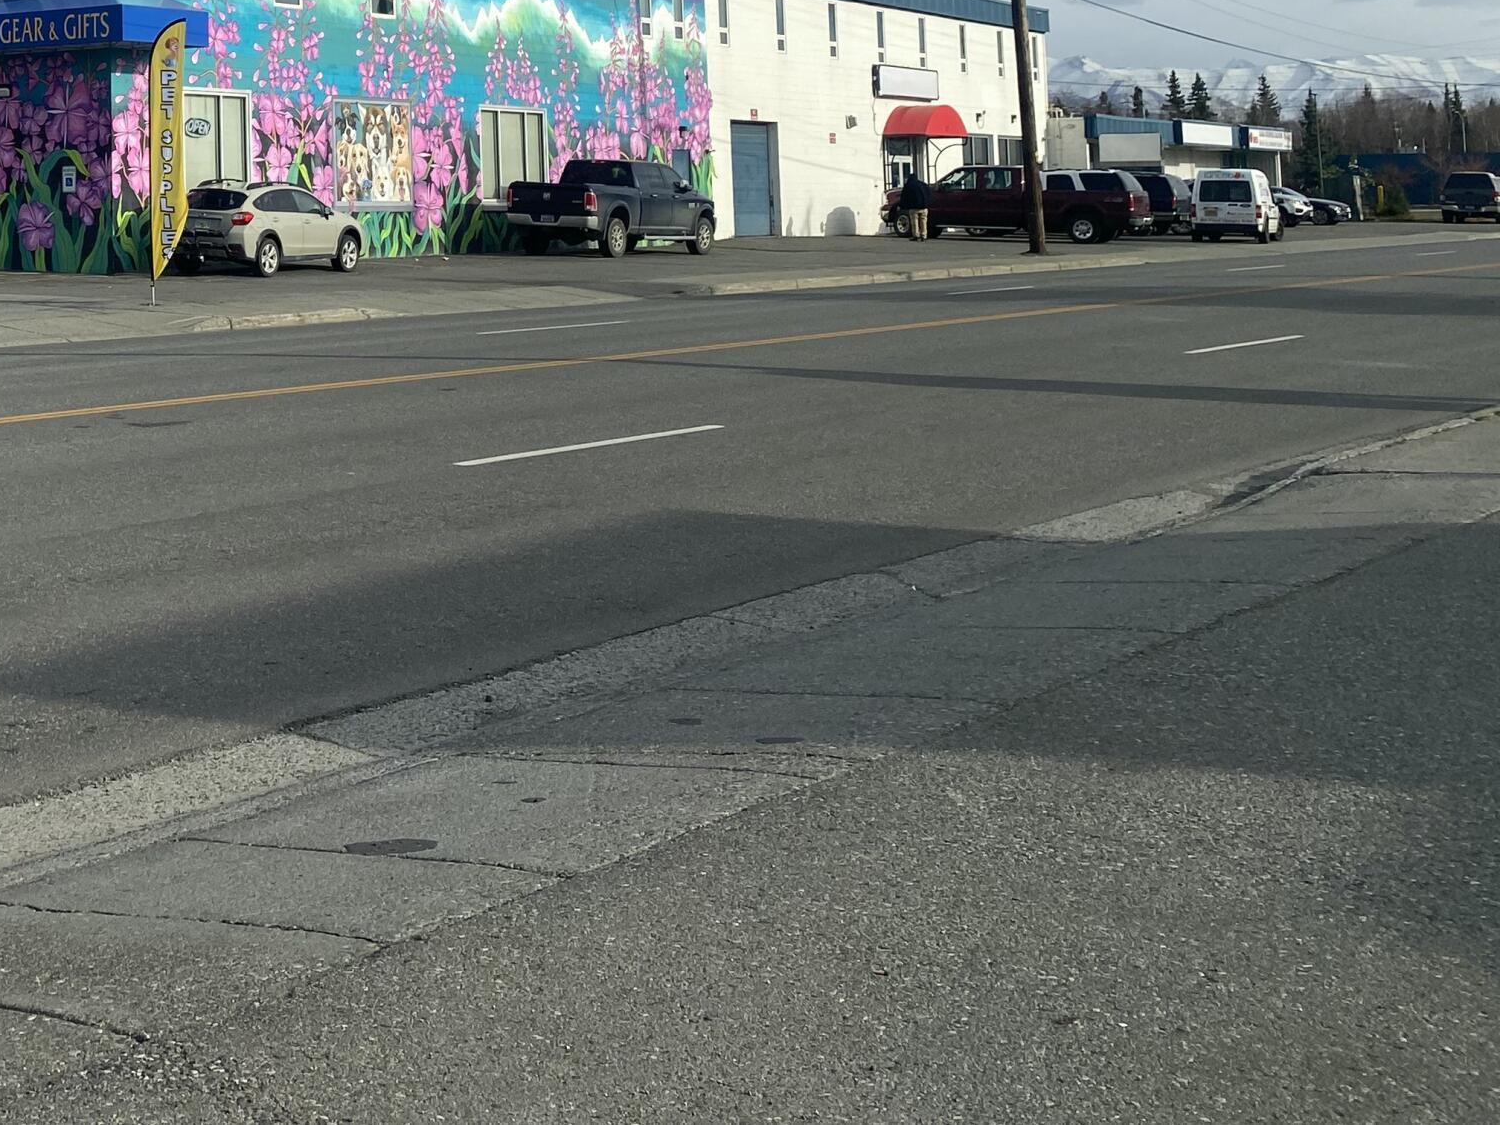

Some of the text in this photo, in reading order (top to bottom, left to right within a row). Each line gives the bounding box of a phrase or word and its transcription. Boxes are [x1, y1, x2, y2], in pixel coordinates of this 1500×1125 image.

[0, 15, 45, 44] GEAR
[49, 21, 60, 41] &
[64, 11, 110, 40] GIFTS
[160, 69, 177, 121] PET
[186, 119, 210, 136] OPEN
